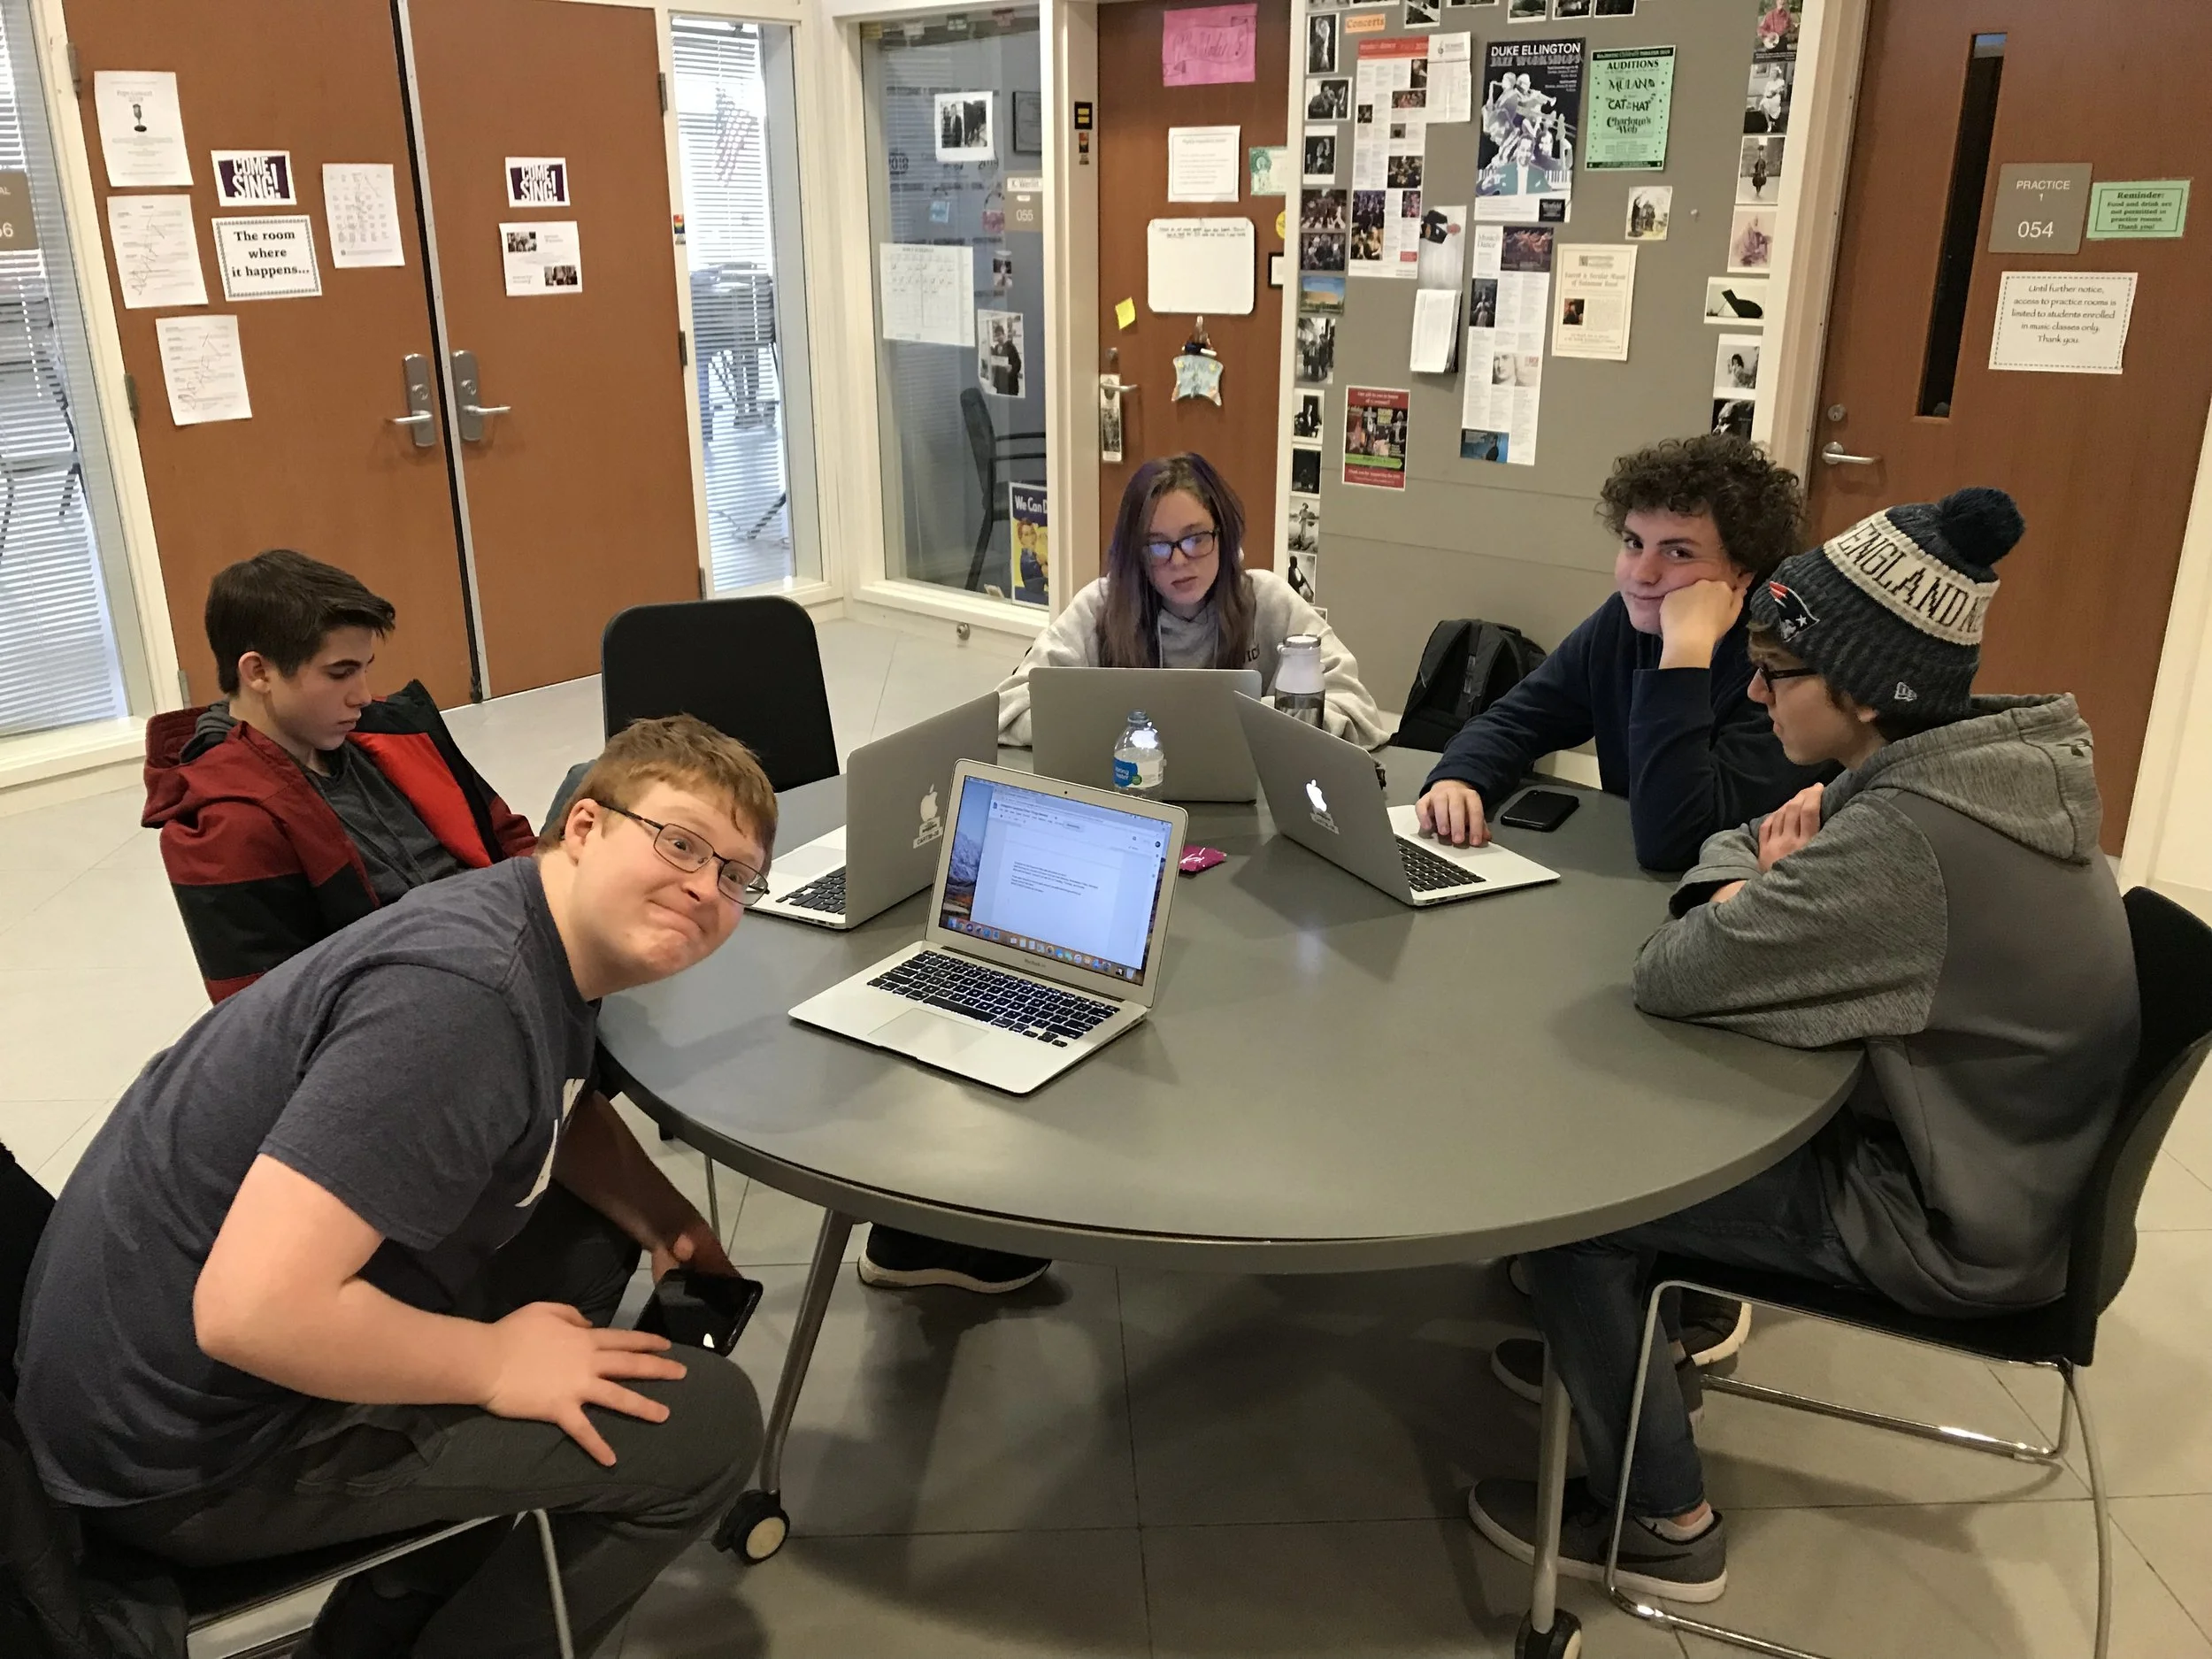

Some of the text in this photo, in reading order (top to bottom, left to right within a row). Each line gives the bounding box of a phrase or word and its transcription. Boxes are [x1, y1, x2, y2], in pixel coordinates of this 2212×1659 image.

[1346, 17, 1385, 28] Concerts
[1491, 42, 1581, 57] DUKE ELLINGTON
[1606, 58, 1660, 70] AUDITIONS
[1608, 78, 1648, 93] MULAN
[1608, 98, 1650, 112] CAT HAT
[233, 156, 270, 176] COME
[521, 164, 551, 181] COME
[231, 163, 281, 199] SING!
[519, 170, 559, 202] SING!
[2016, 180, 2071, 190] PRACTICE
[2039, 192, 2044, 202] 1
[1015, 208, 1034, 222] 055
[0, 221, 14, 238] 6
[233, 230, 296, 242] The room
[2017, 220, 2054, 238] 054
[248, 247, 288, 259] where
[231, 265, 311, 280] it happens...
[2028, 283, 2105, 295] Until further notice,
[2050, 298, 2083, 309] practice
[2011, 308, 2036, 318] limited
[2047, 310, 2082, 319] students
[2082, 310, 2116, 319] enrolled
[2051, 322, 2080, 331] classes
[2037, 334, 2062, 343] Thank
[1015, 495, 1026, 511] We
[1027, 495, 1042, 514] Can
[1838, 522, 1970, 627] ENGLAND
